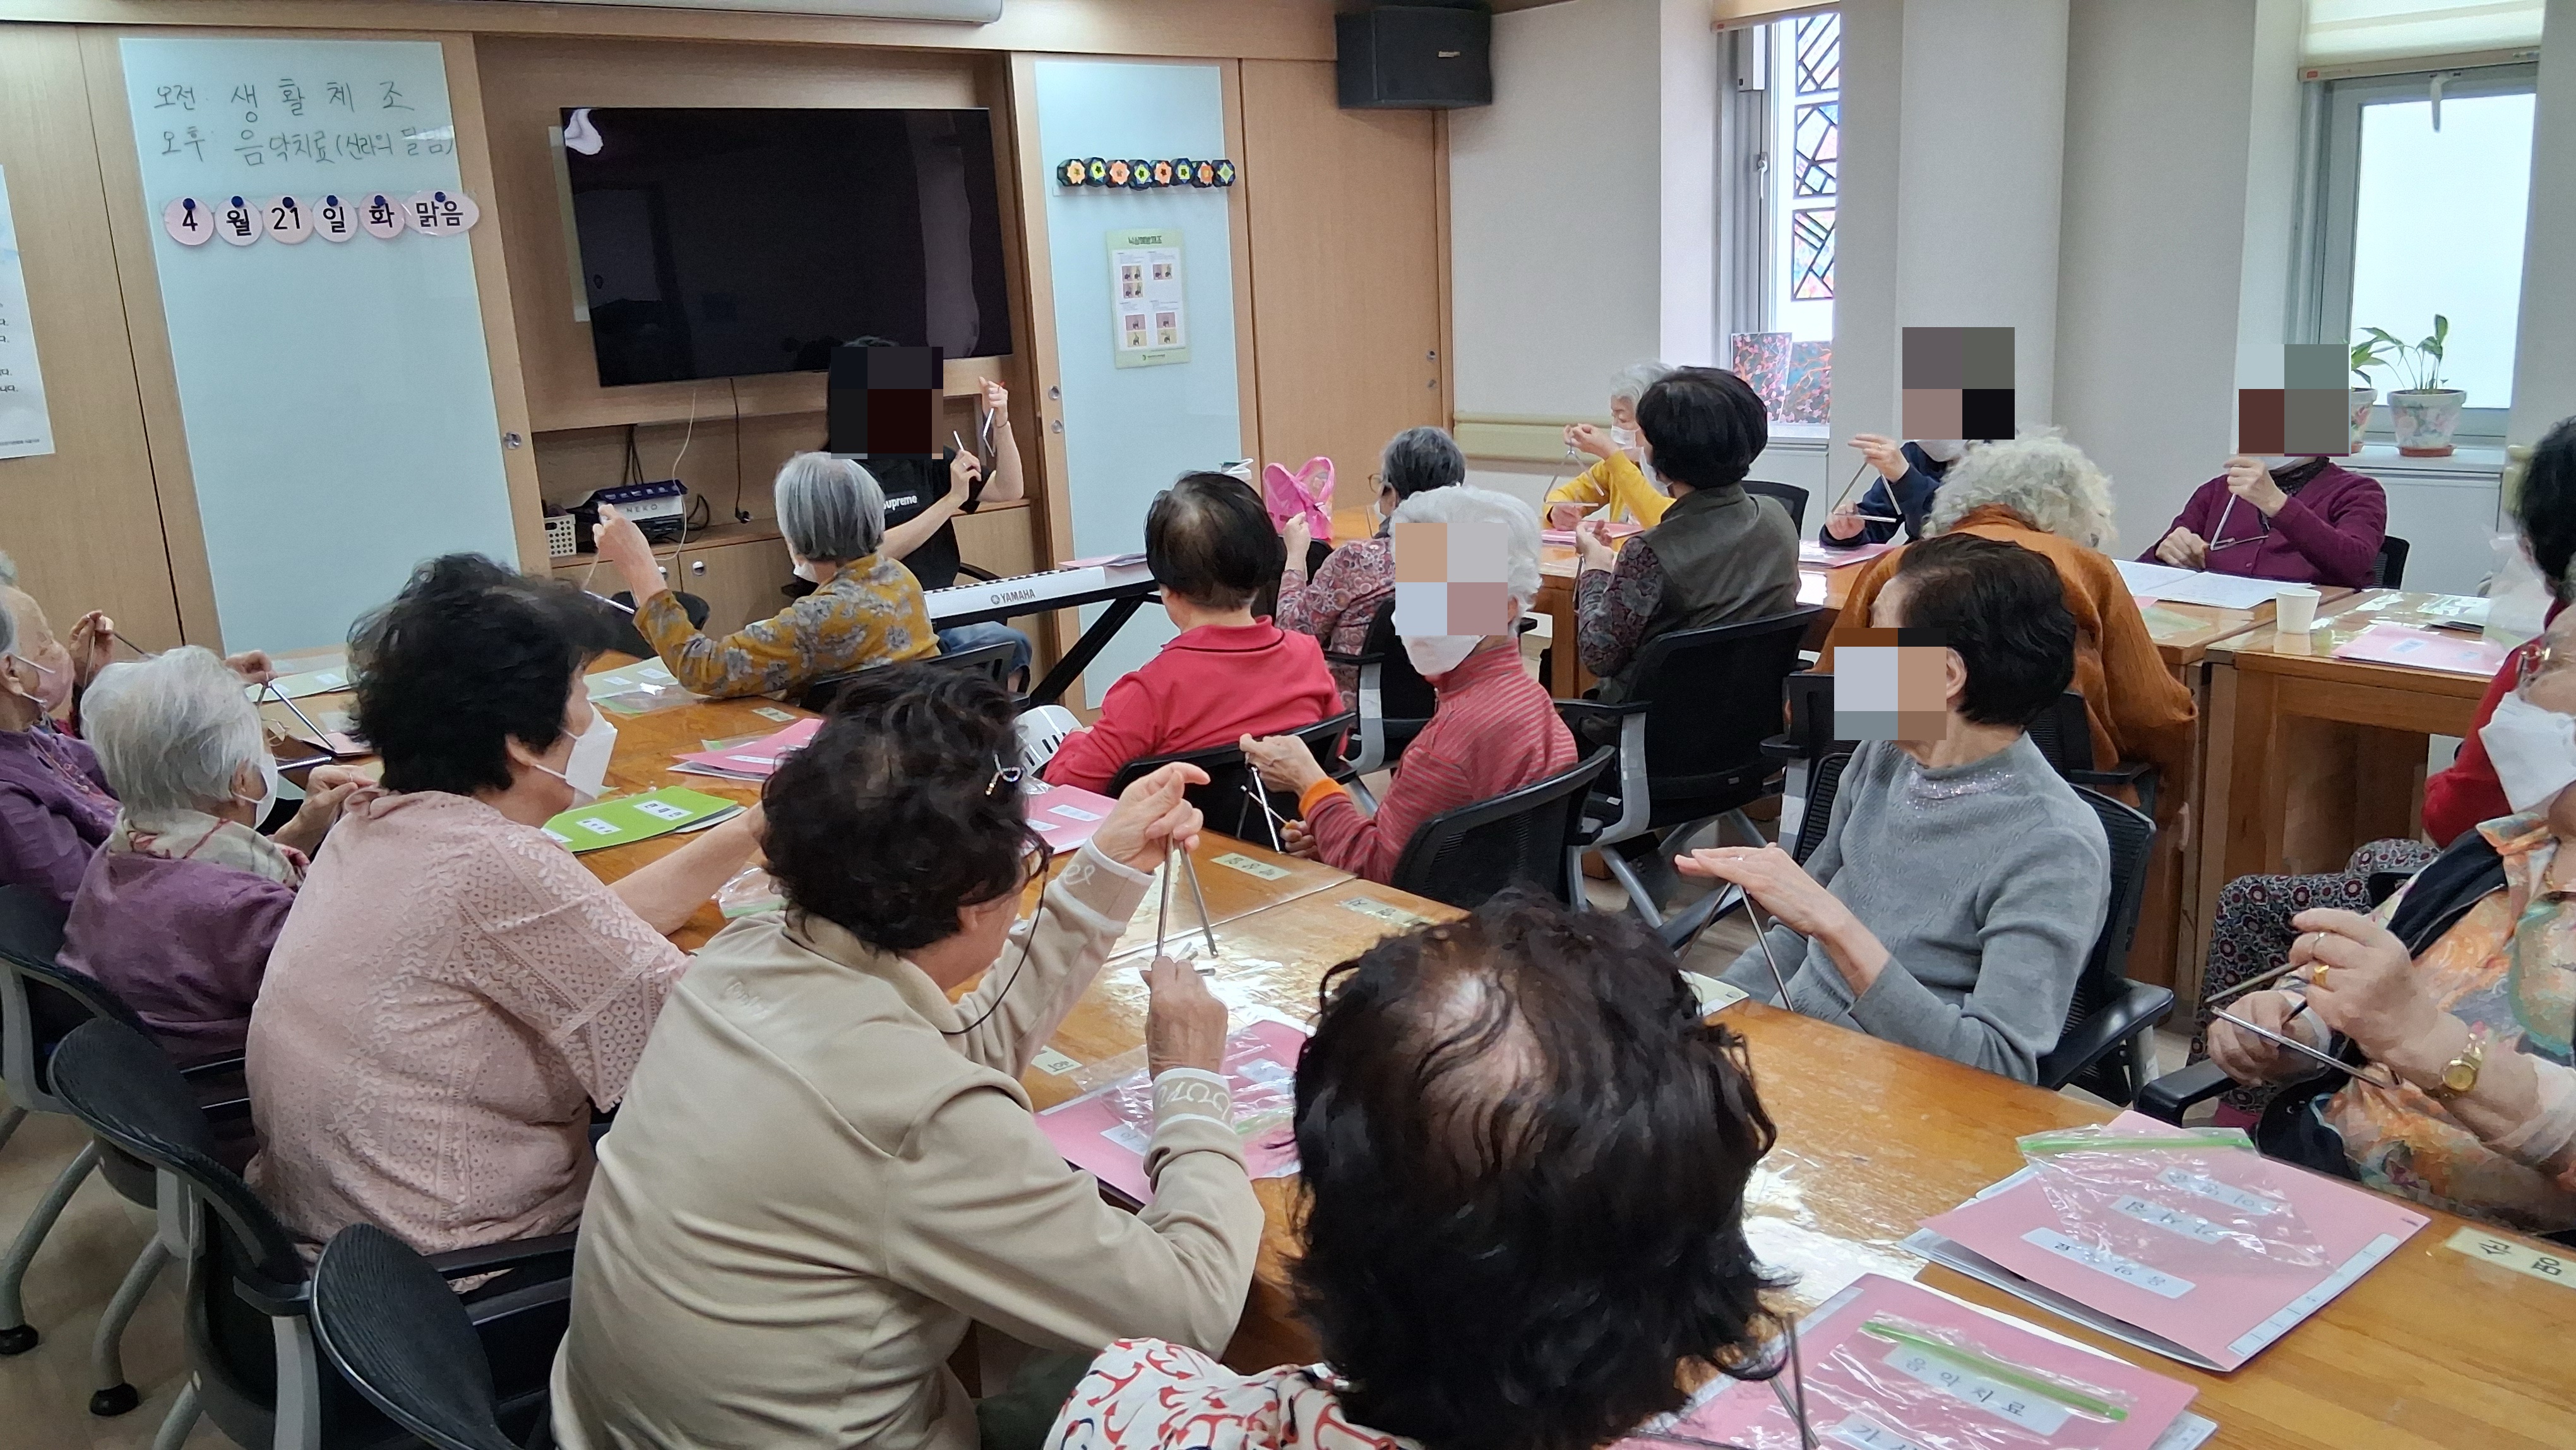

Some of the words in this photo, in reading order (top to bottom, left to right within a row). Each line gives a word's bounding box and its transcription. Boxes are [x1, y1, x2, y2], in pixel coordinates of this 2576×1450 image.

[154, 85, 195, 110] 오전
[162, 126, 205, 162] 오후
[271, 207, 302, 231] 21
[415, 200, 464, 230] 맑음
[1000, 589, 1036, 603] YAMAHA
